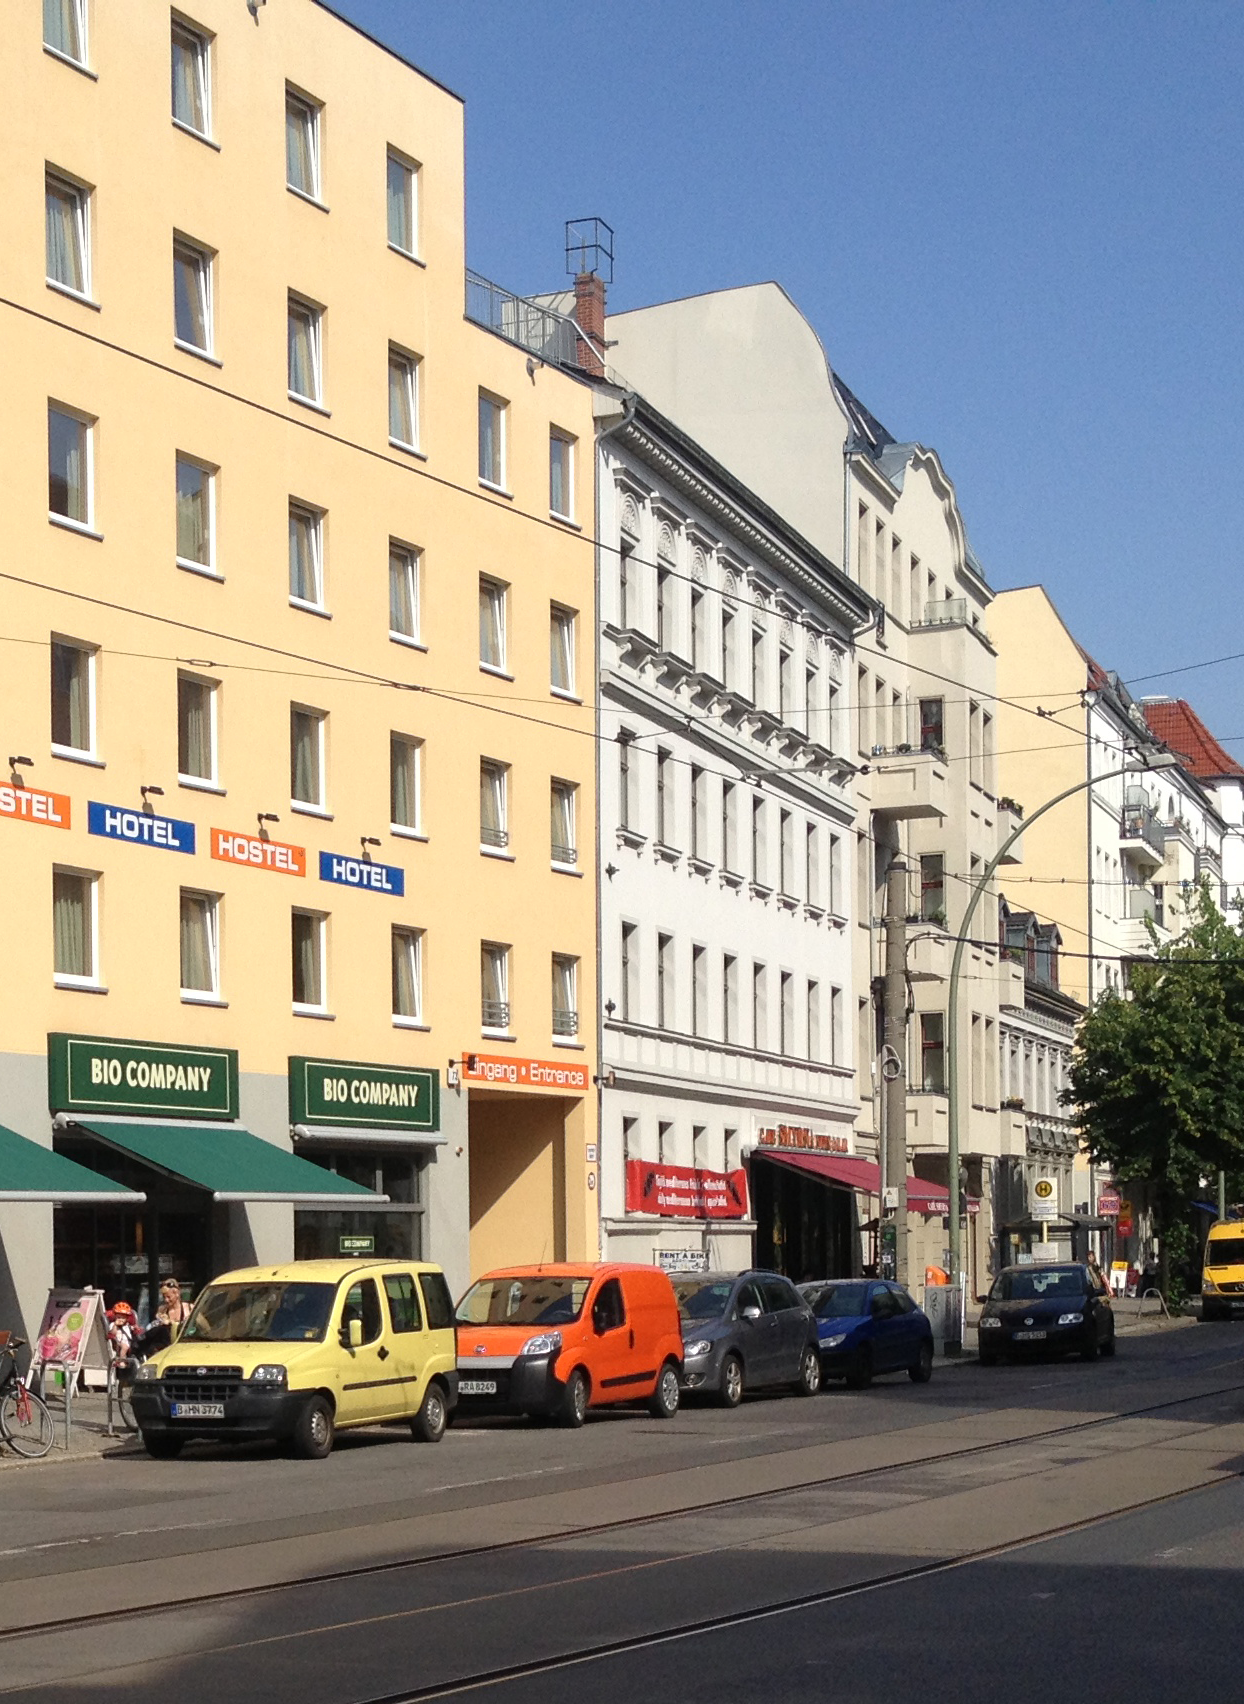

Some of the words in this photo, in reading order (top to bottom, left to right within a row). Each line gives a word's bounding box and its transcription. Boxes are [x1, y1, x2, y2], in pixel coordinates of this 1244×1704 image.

[105, 809, 180, 847] HOTEL
[218, 834, 299, 871] HOSTEL
[332, 858, 392, 890] HOTEL
[91, 1057, 122, 1086] BIO
[126, 1060, 212, 1092] COMPANY
[530, 1063, 584, 1085] Entrance
[323, 1077, 348, 1102] BIO
[350, 1079, 419, 1108] COMPANY
